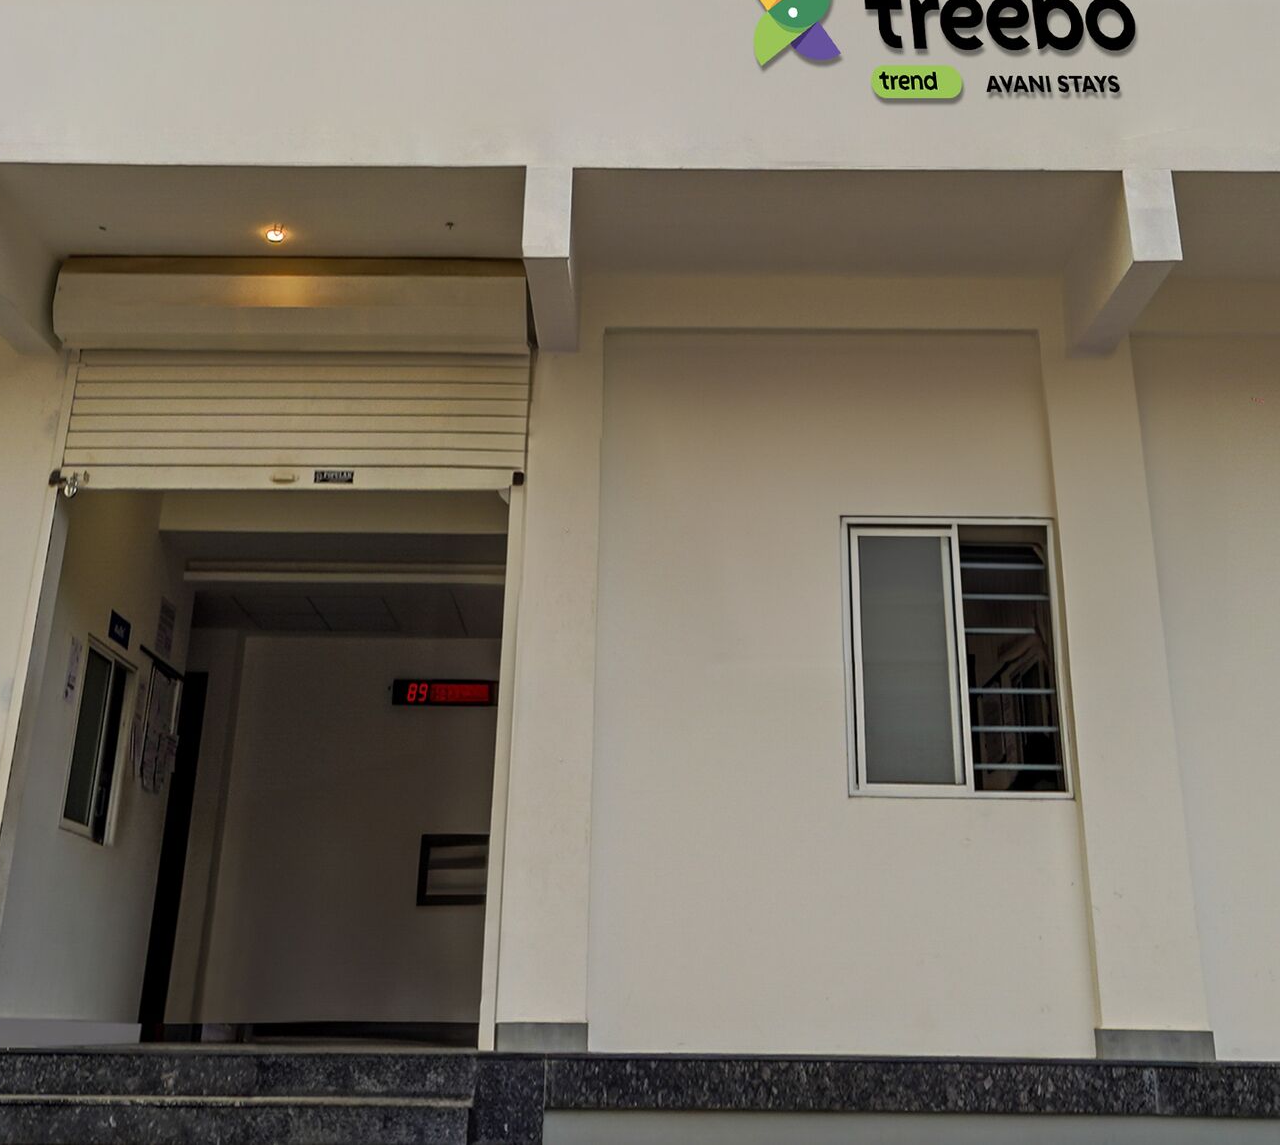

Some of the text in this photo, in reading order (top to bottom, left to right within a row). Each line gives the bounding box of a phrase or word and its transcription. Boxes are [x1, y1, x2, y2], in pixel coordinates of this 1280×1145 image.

[879, 71, 938, 91] trend
[986, 75, 1120, 93] AVANI STAYS
